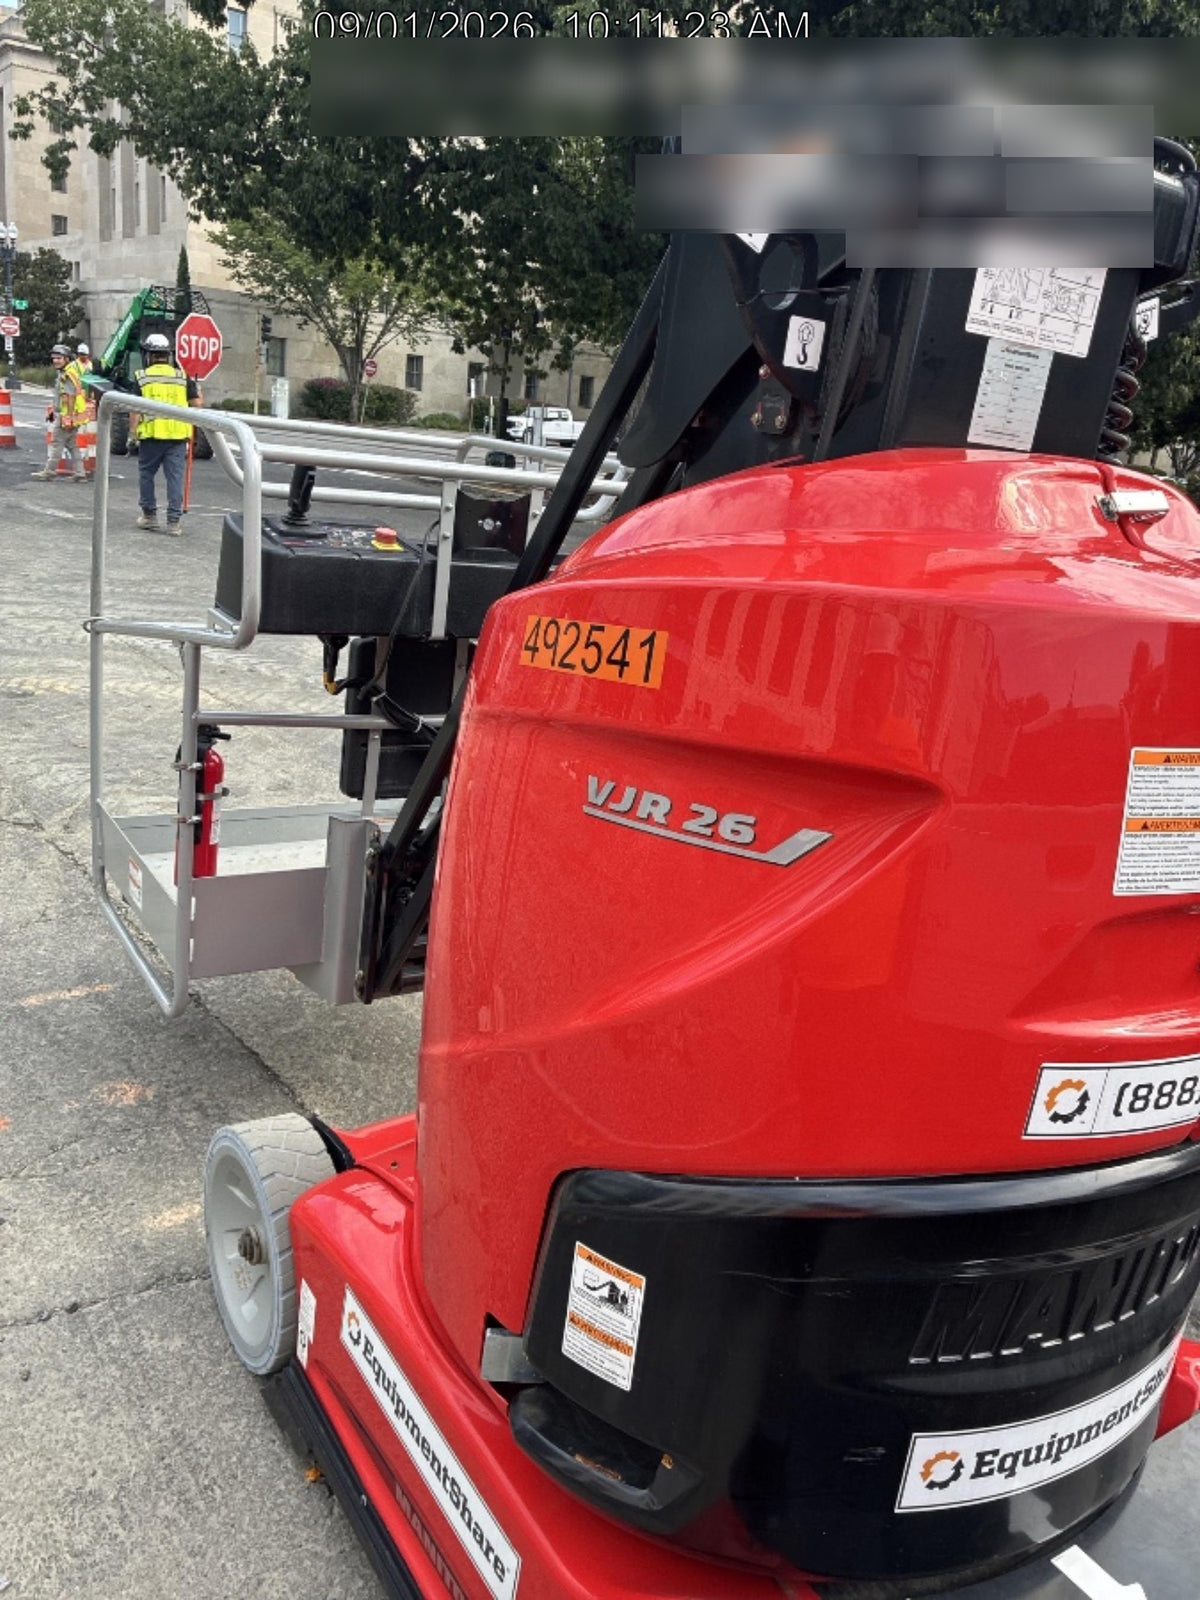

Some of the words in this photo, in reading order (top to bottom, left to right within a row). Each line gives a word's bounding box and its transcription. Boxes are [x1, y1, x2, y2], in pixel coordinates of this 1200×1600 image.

[180, 334, 219, 361] STOP
[524, 617, 657, 683] 492541
[587, 774, 672, 825] VJR
[682, 802, 757, 845] 26
[1113, 1076, 1200, 1117] (888
[361, 1333, 507, 1584] EquipmentShare
